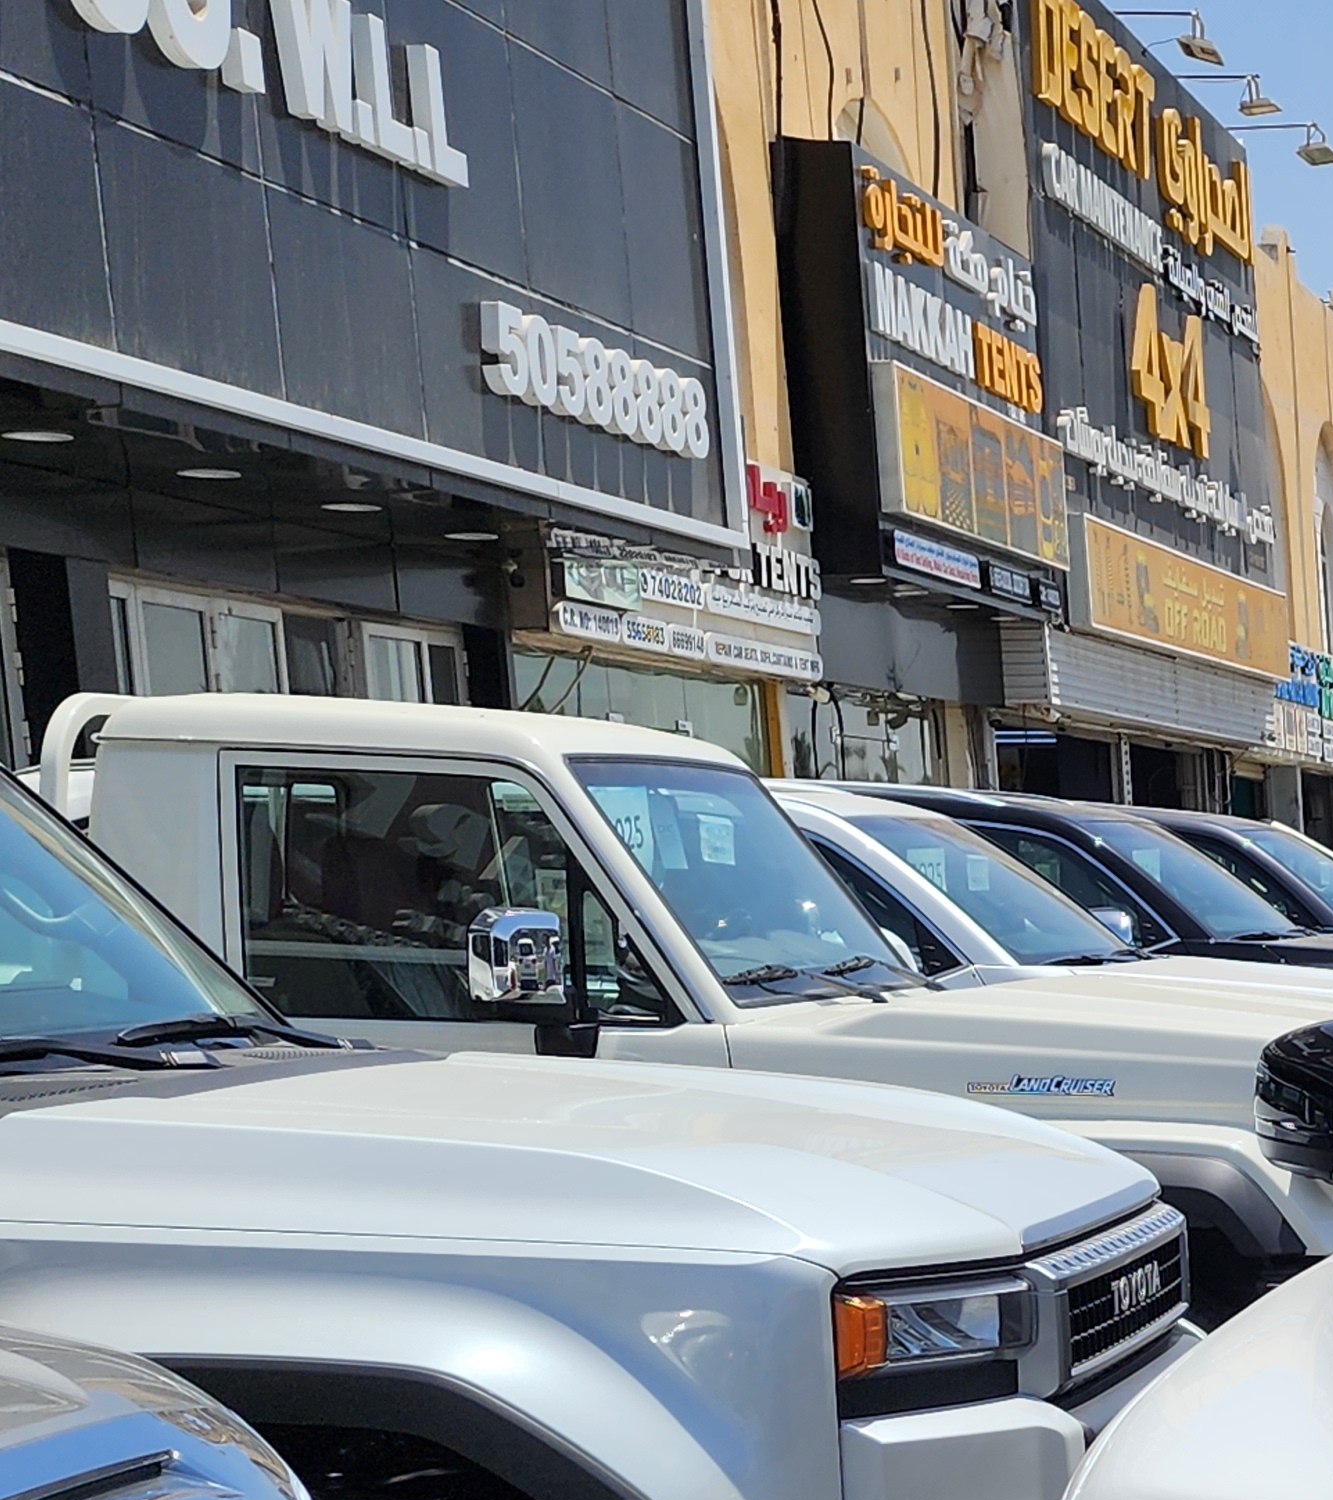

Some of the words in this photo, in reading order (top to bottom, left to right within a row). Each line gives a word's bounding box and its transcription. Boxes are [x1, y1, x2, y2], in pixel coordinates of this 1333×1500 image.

[1030, 0, 1155, 180] DESERT
[1041, 142, 1077, 209] CAR
[1078, 163, 1163, 272] MAINTENANCE
[941, 219, 988, 295] مكة
[867, 260, 975, 380] MAKKAH
[974, 321, 1043, 414] TENTS
[481, 300, 710, 459] 50588888
[650, 575, 702, 606] 74028202
[754, 543, 821, 600] TENTS
[1164, 598, 1188, 641] OFF
[1193, 608, 1227, 654] ROAD
[1111, 1260, 1161, 1316] TOYOTA
